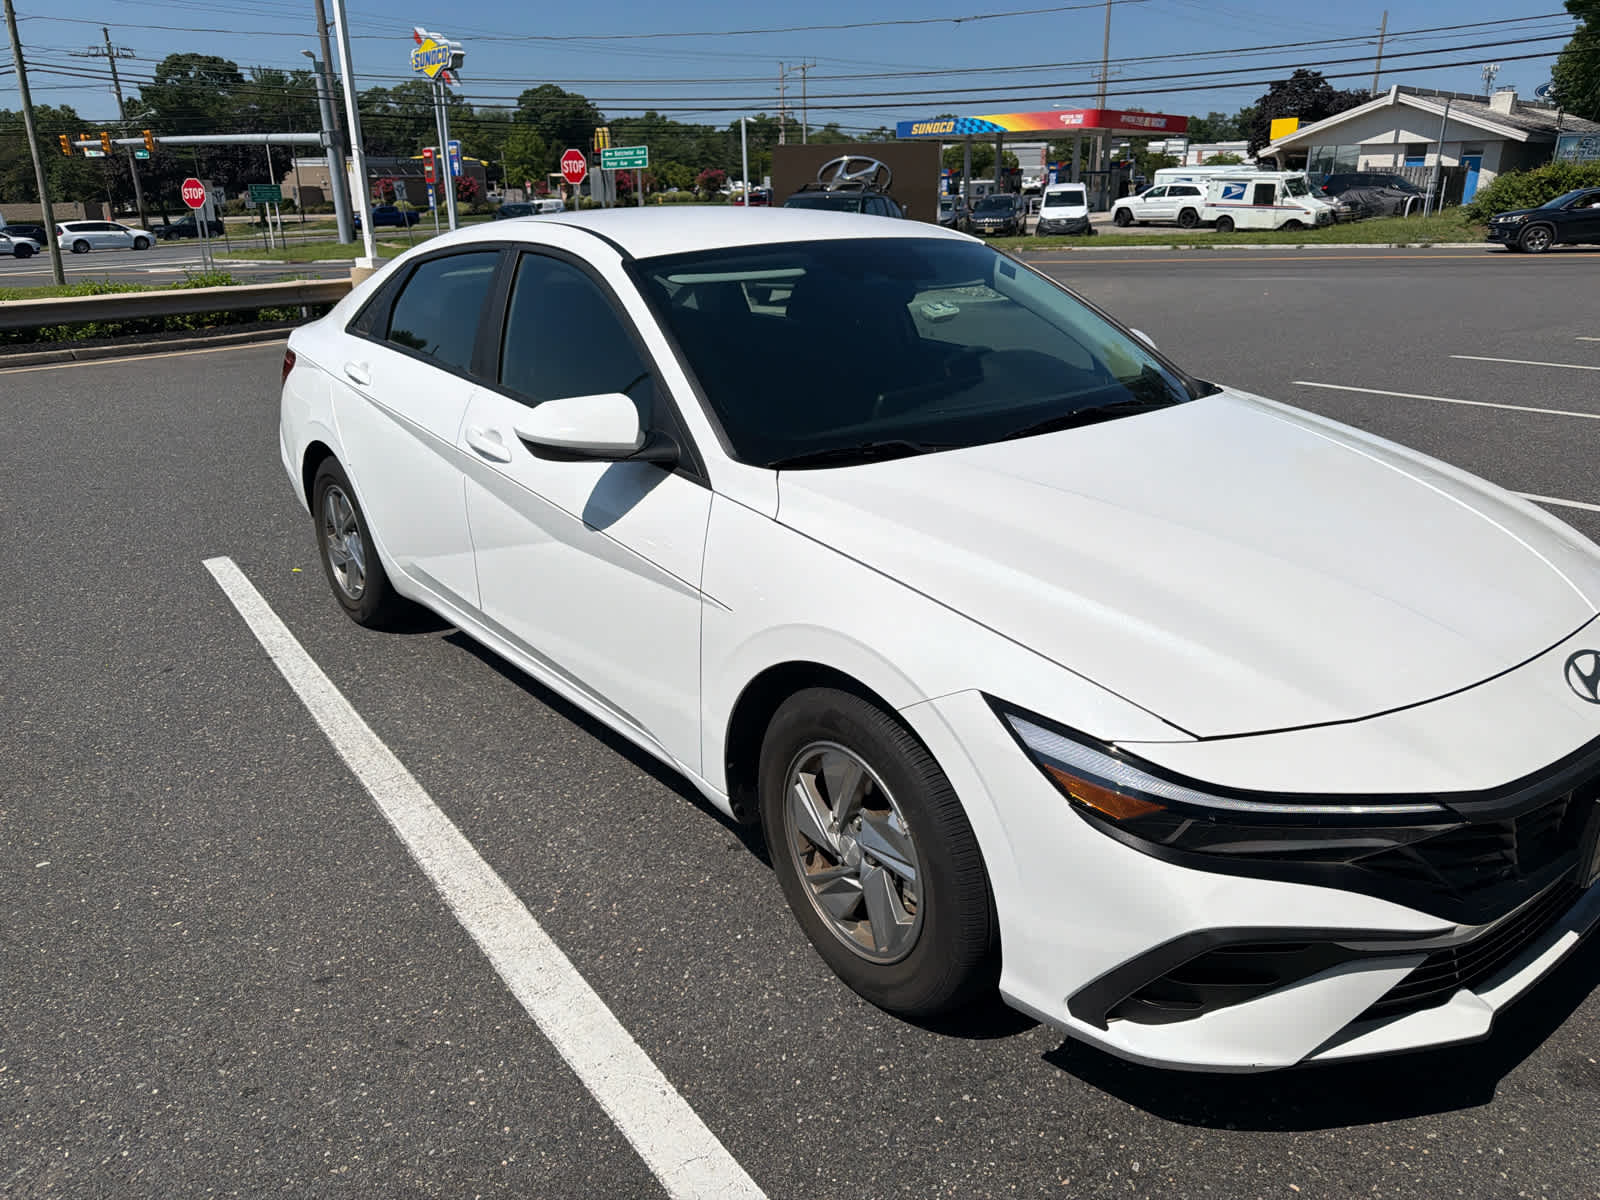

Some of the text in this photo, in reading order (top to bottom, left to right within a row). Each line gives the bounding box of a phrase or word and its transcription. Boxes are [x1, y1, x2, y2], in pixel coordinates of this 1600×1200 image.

[414, 48, 447, 68] SUNOCO
[911, 121, 954, 135] SUNOCO
[563, 160, 585, 173] STOP
[184, 187, 204, 199] STOP
